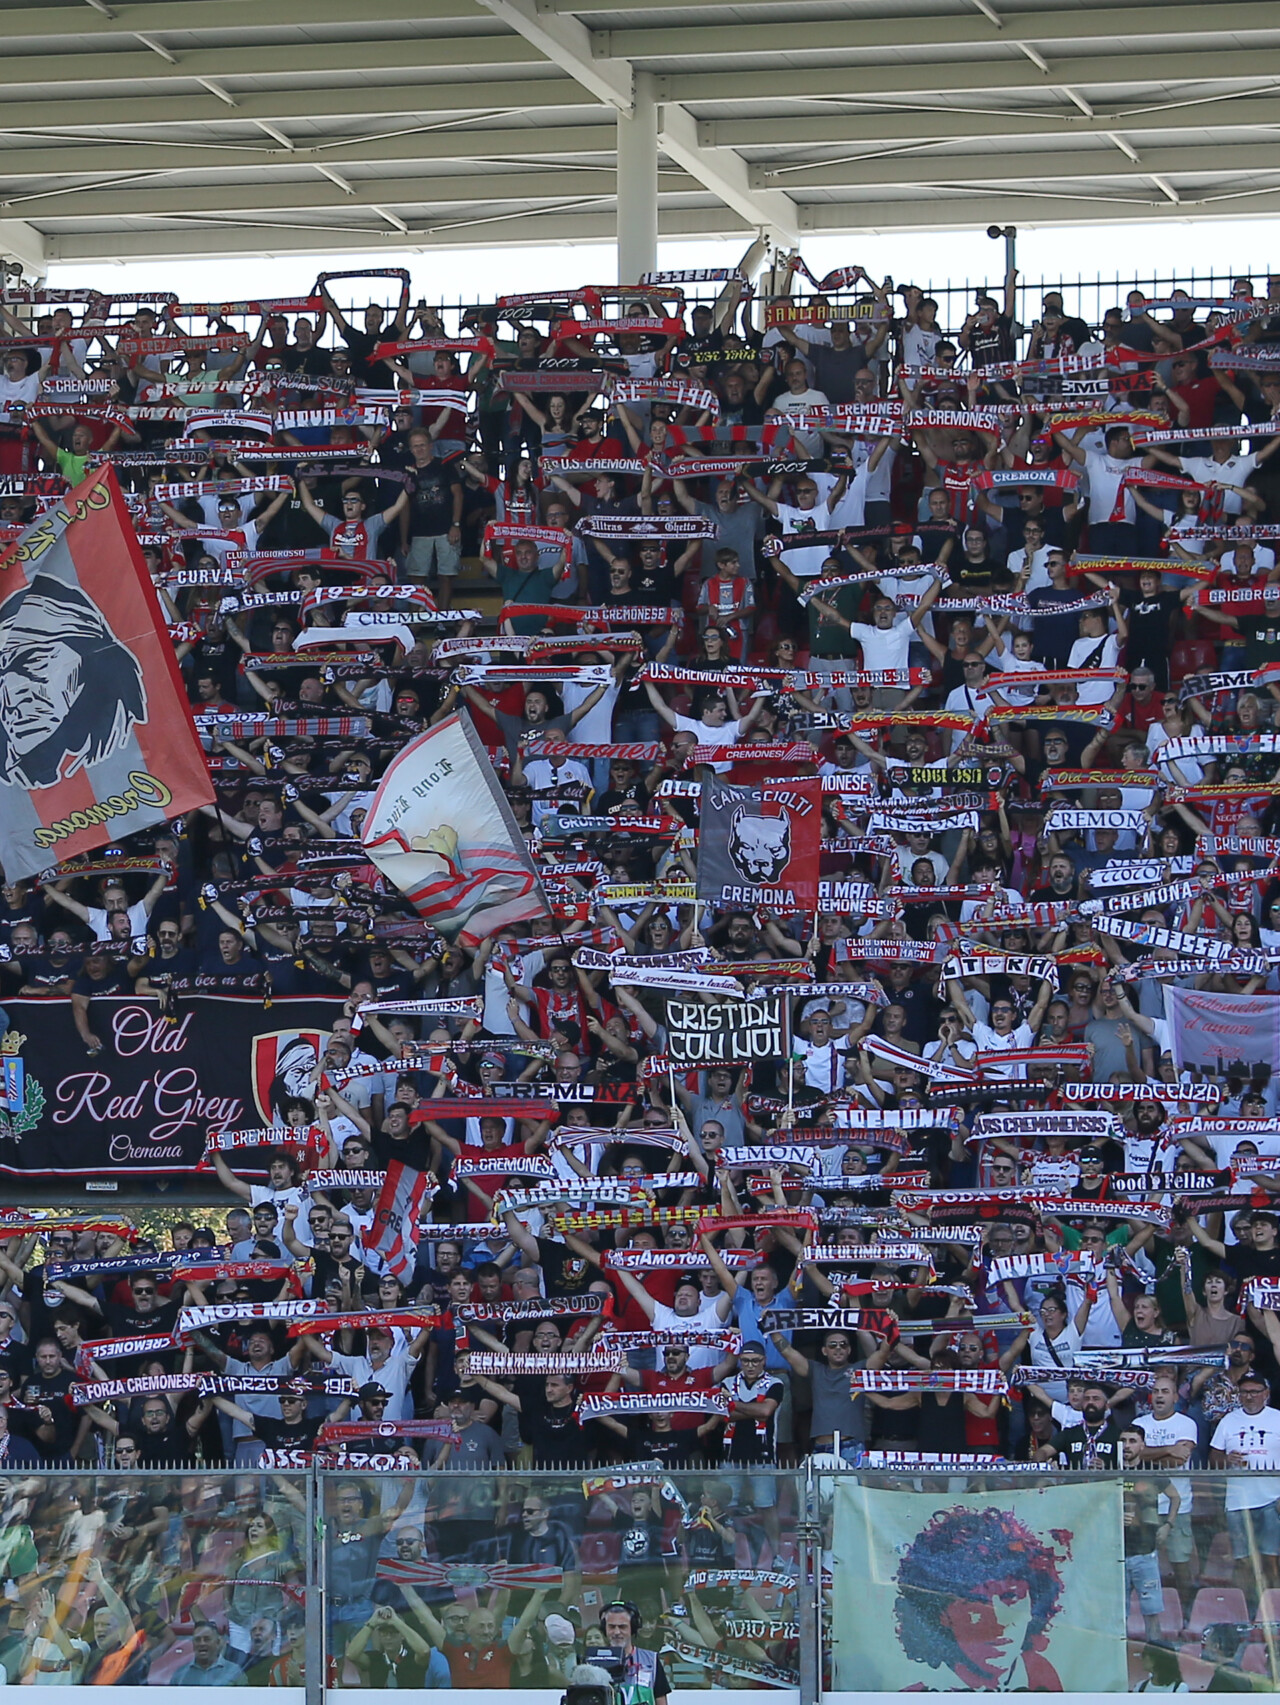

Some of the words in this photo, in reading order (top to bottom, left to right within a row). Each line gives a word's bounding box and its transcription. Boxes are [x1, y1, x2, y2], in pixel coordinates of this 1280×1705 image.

[173, 304, 256, 315] CHERNOBYL
[497, 306, 533, 319] 1903
[538, 356, 580, 369] 1903
[992, 471, 1056, 482] CREMONA
[590, 520, 623, 532] Ultras
[664, 520, 697, 533] Ghetto
[177, 569, 233, 584] CURVA
[602, 608, 665, 620] CREMONESE
[650, 662, 671, 679] U.S.
[726, 750, 784, 760] CREMONESI
[1057, 771, 1082, 783] Old
[1088, 771, 1116, 782] Red
[1121, 771, 1153, 786] Grey
[710, 788, 747, 811] CANI
[751, 790, 814, 817] SCIOLTI
[721, 884, 796, 905] CREMONA
[1108, 882, 1193, 911] CREMONA
[900, 949, 930, 959] MAGNI
[1154, 959, 1220, 975] CURVA
[666, 1001, 780, 1030] CRISTIAN
[111, 1006, 195, 1064] Old
[670, 1031, 724, 1061] CON
[732, 1028, 781, 1057] NOI
[491, 1082, 637, 1101] CREMONA
[1066, 1083, 1114, 1101] ODIO
[1118, 1083, 1220, 1103] PIACENZA
[52, 1071, 152, 1124] Red
[146, 1067, 244, 1141] Grey
[232, 1126, 309, 1144] CREMONESE
[108, 1134, 183, 1162] Cremona
[549, 1292, 602, 1313] SUD
[180, 1304, 256, 1330] AMOR
[263, 1300, 318, 1321] MIO
[87, 1380, 126, 1400] FORZA
[127, 1373, 197, 1395] CREMONESE
[588, 1392, 618, 1411] U.S.
[620, 1391, 708, 1409] CREMONESE
